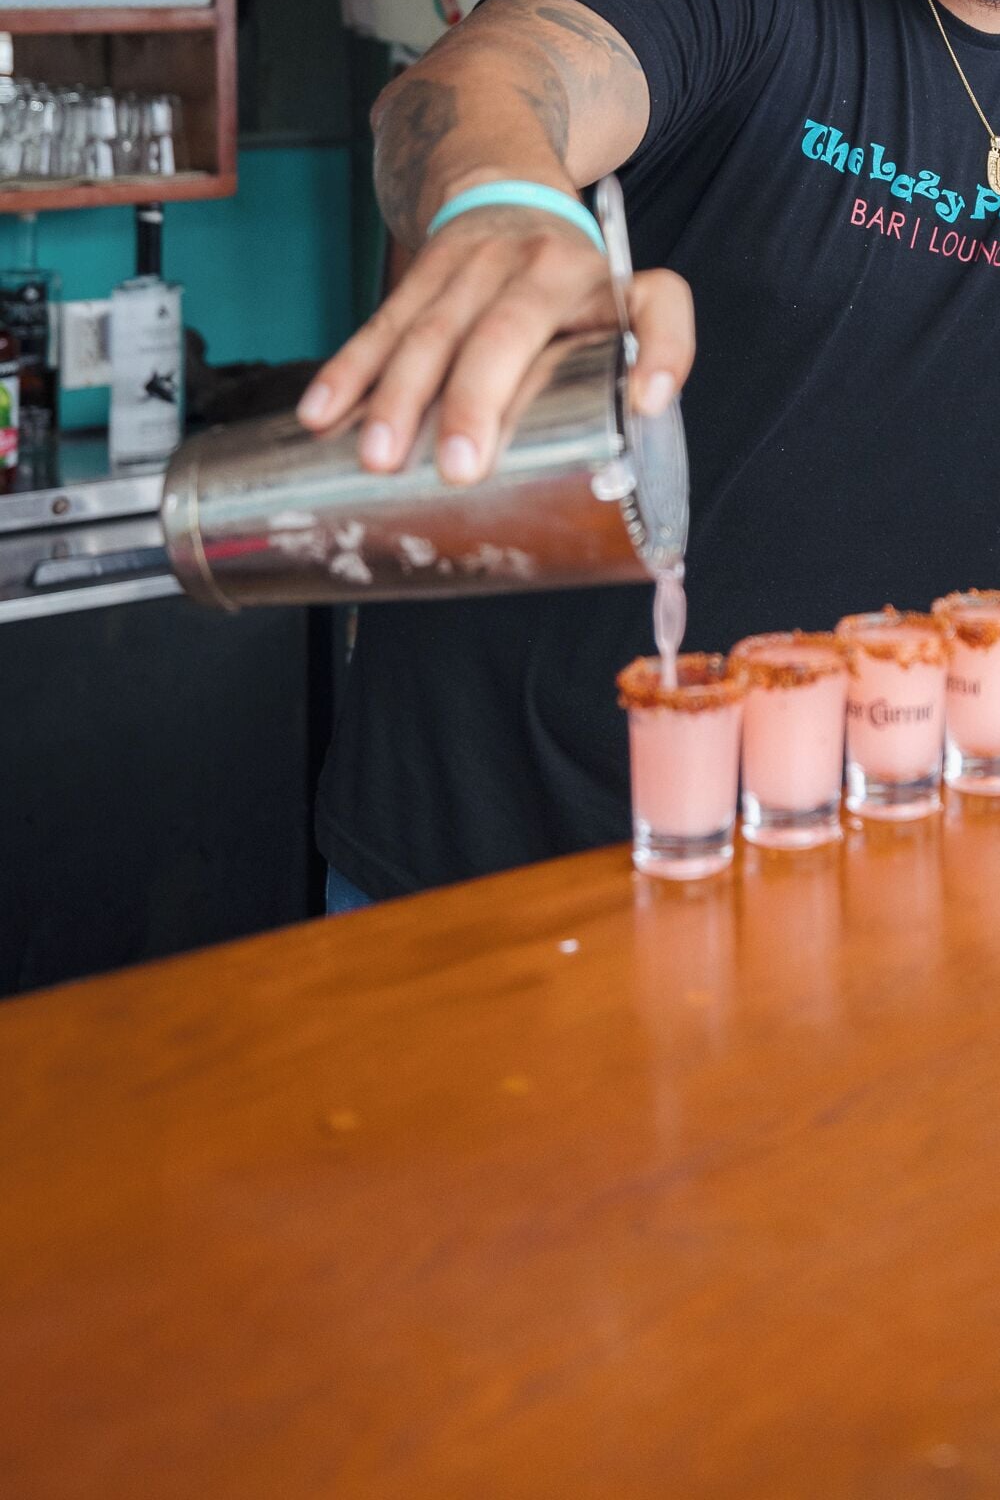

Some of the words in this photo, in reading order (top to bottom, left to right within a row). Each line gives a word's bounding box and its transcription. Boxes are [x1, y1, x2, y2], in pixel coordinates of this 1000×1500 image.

[801, 119, 864, 175] The
[869, 143, 965, 223] Lazy
[850, 199, 905, 239] BAR
